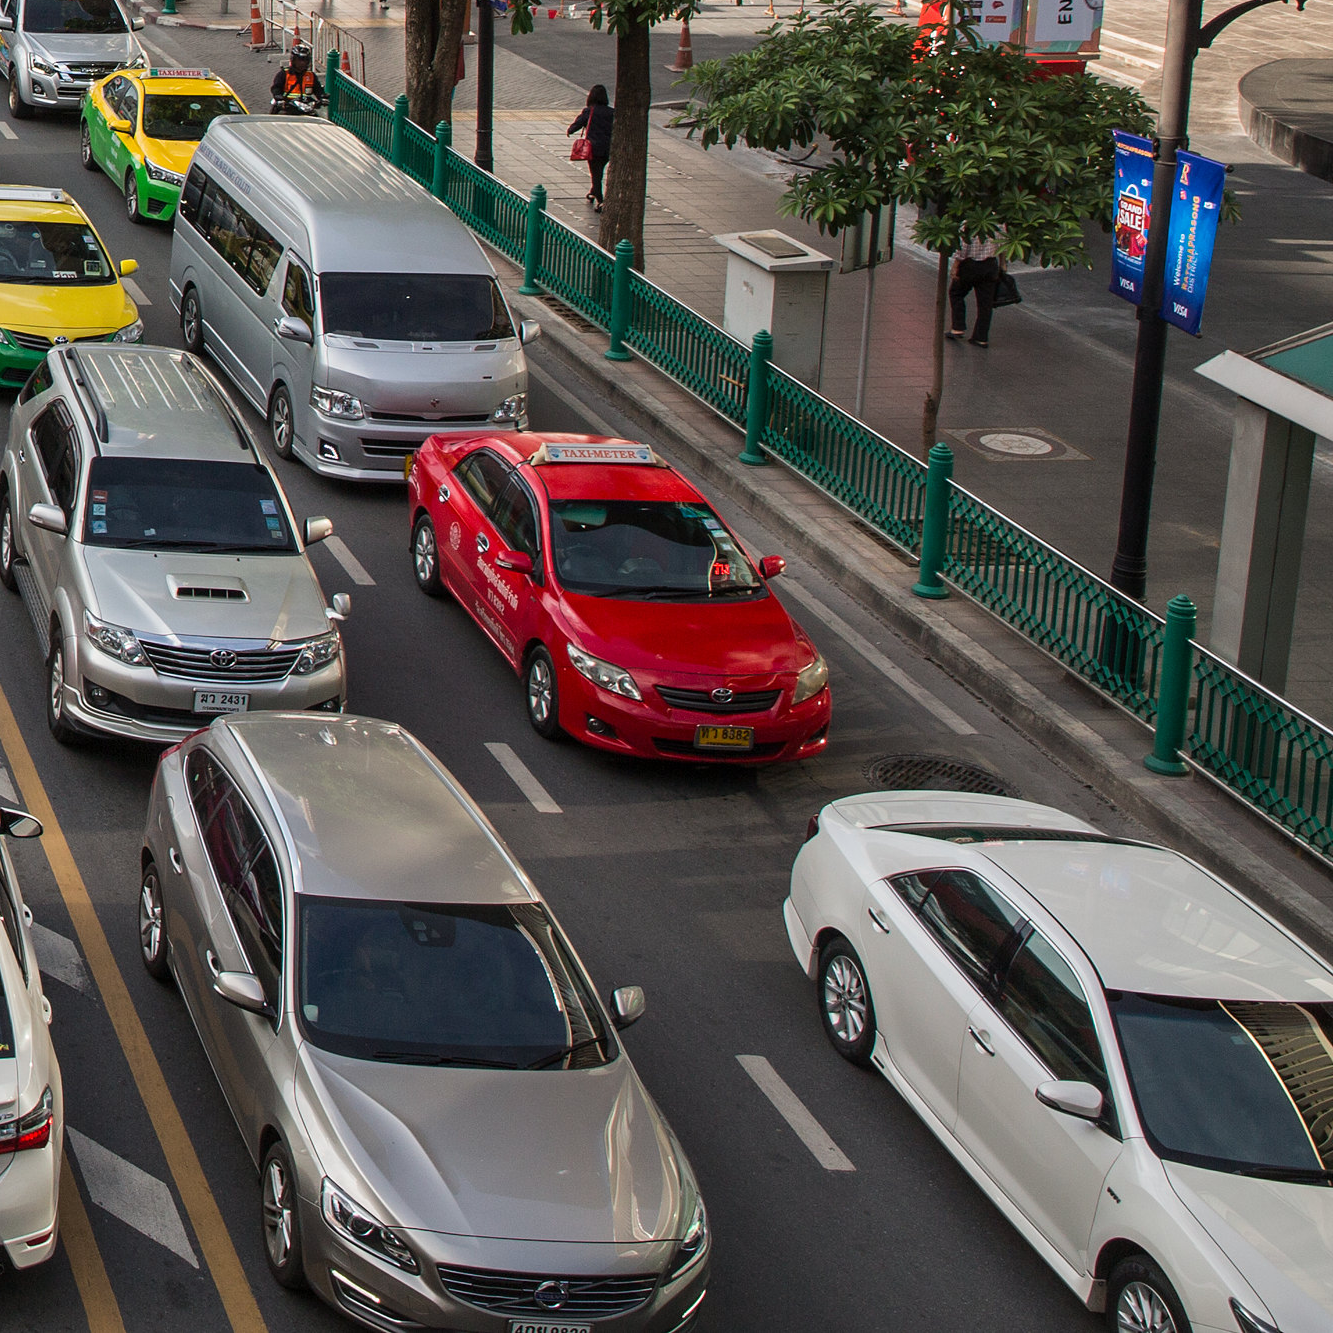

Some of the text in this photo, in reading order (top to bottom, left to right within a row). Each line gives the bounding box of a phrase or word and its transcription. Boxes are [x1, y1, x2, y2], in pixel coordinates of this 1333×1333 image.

[1119, 210, 1143, 231] SALE
[1181, 196, 1201, 291] RATCHAPRASONG
[1173, 245, 1184, 286] Welcome
[1119, 277, 1135, 292] VISA
[1173, 302, 1188, 318] VISA
[561, 448, 637, 459] TAXI-METER
[220, 695, 246, 706] 2431
[722, 729, 750, 741] 8382
